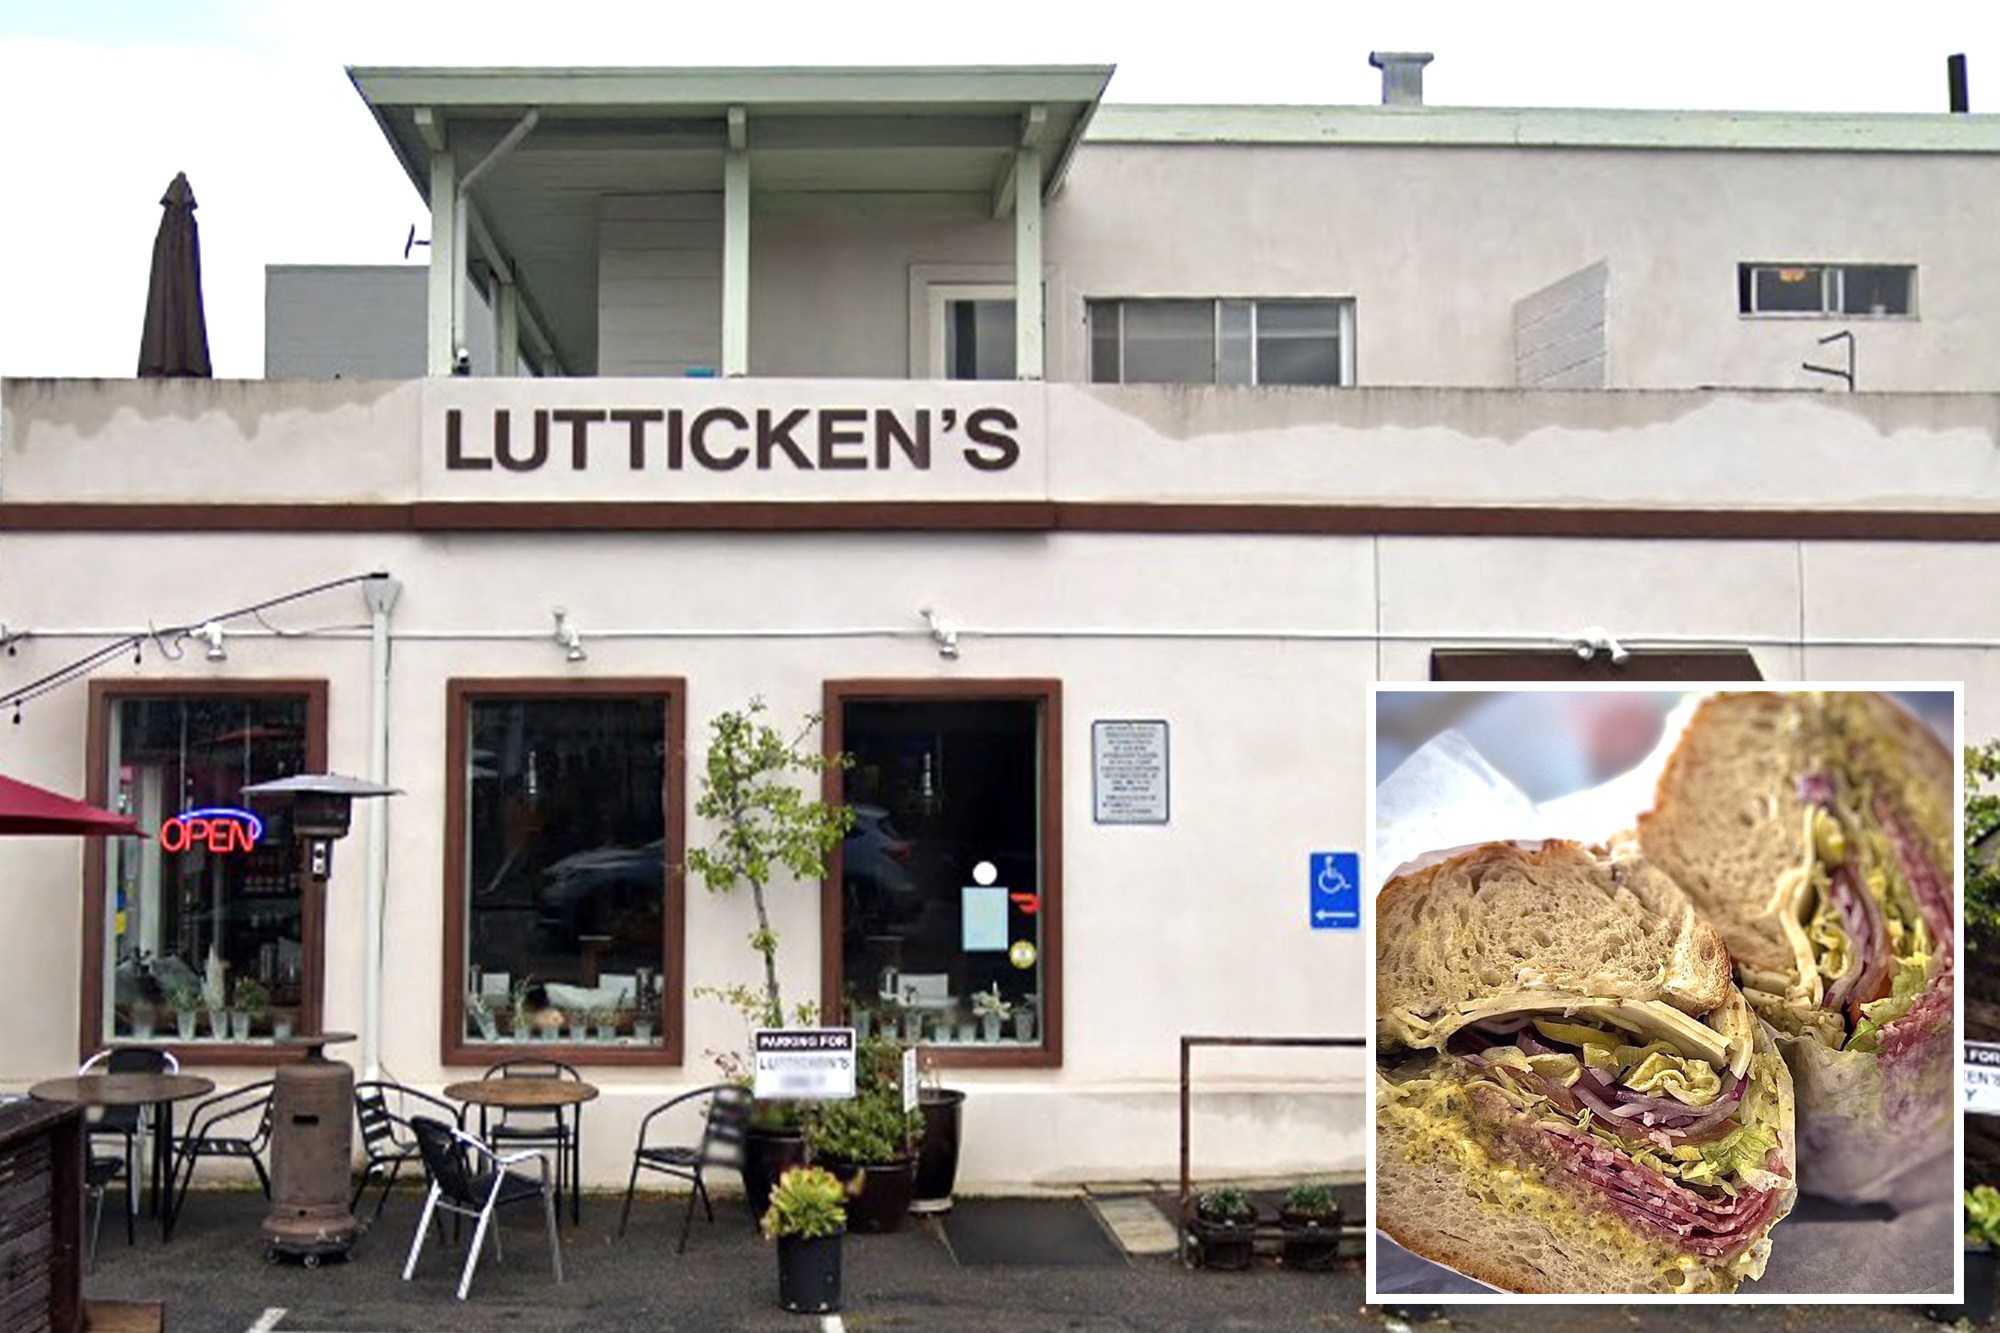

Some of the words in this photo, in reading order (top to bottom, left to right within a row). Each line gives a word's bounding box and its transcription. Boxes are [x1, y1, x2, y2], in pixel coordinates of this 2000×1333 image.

[445, 408, 1021, 472] LUTTICKEN'S
[160, 818, 254, 853] OPEN
[760, 1035, 817, 1047] PARKING
[820, 1035, 848, 1047] FOR
